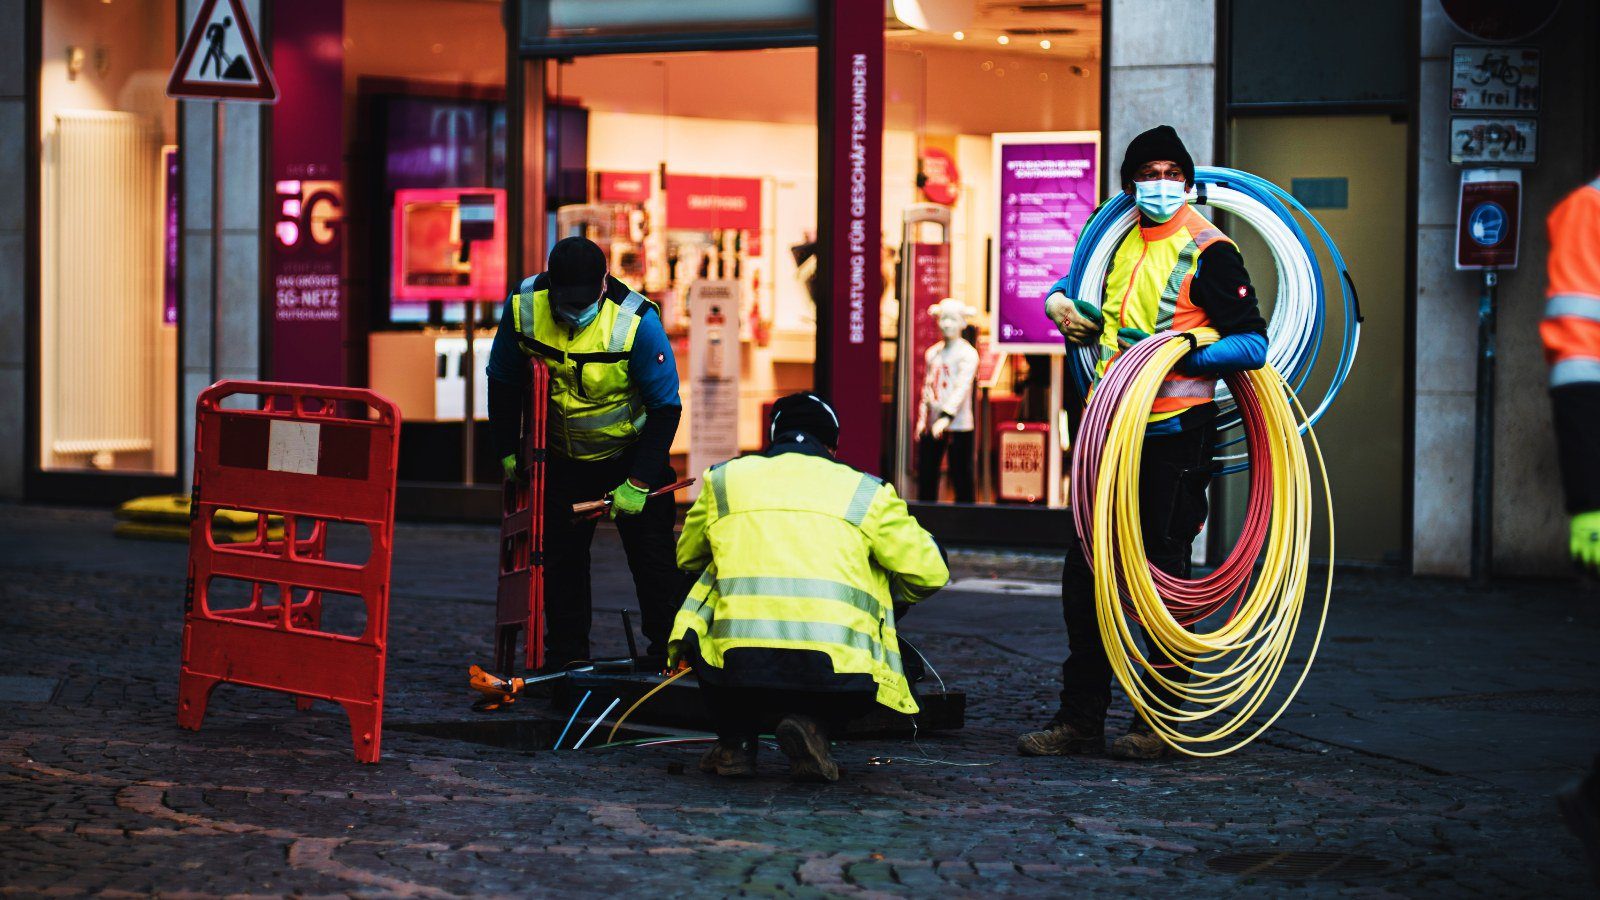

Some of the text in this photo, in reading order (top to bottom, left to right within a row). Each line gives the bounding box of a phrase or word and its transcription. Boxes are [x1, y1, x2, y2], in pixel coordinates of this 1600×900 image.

[1481, 89, 1509, 105] frei
[274, 183, 343, 250] 5G
[848, 54, 867, 343] BERATUNG FÜR GESCHÄFTSKUNDEN
[276, 289, 339, 307] 5G-NETZ
